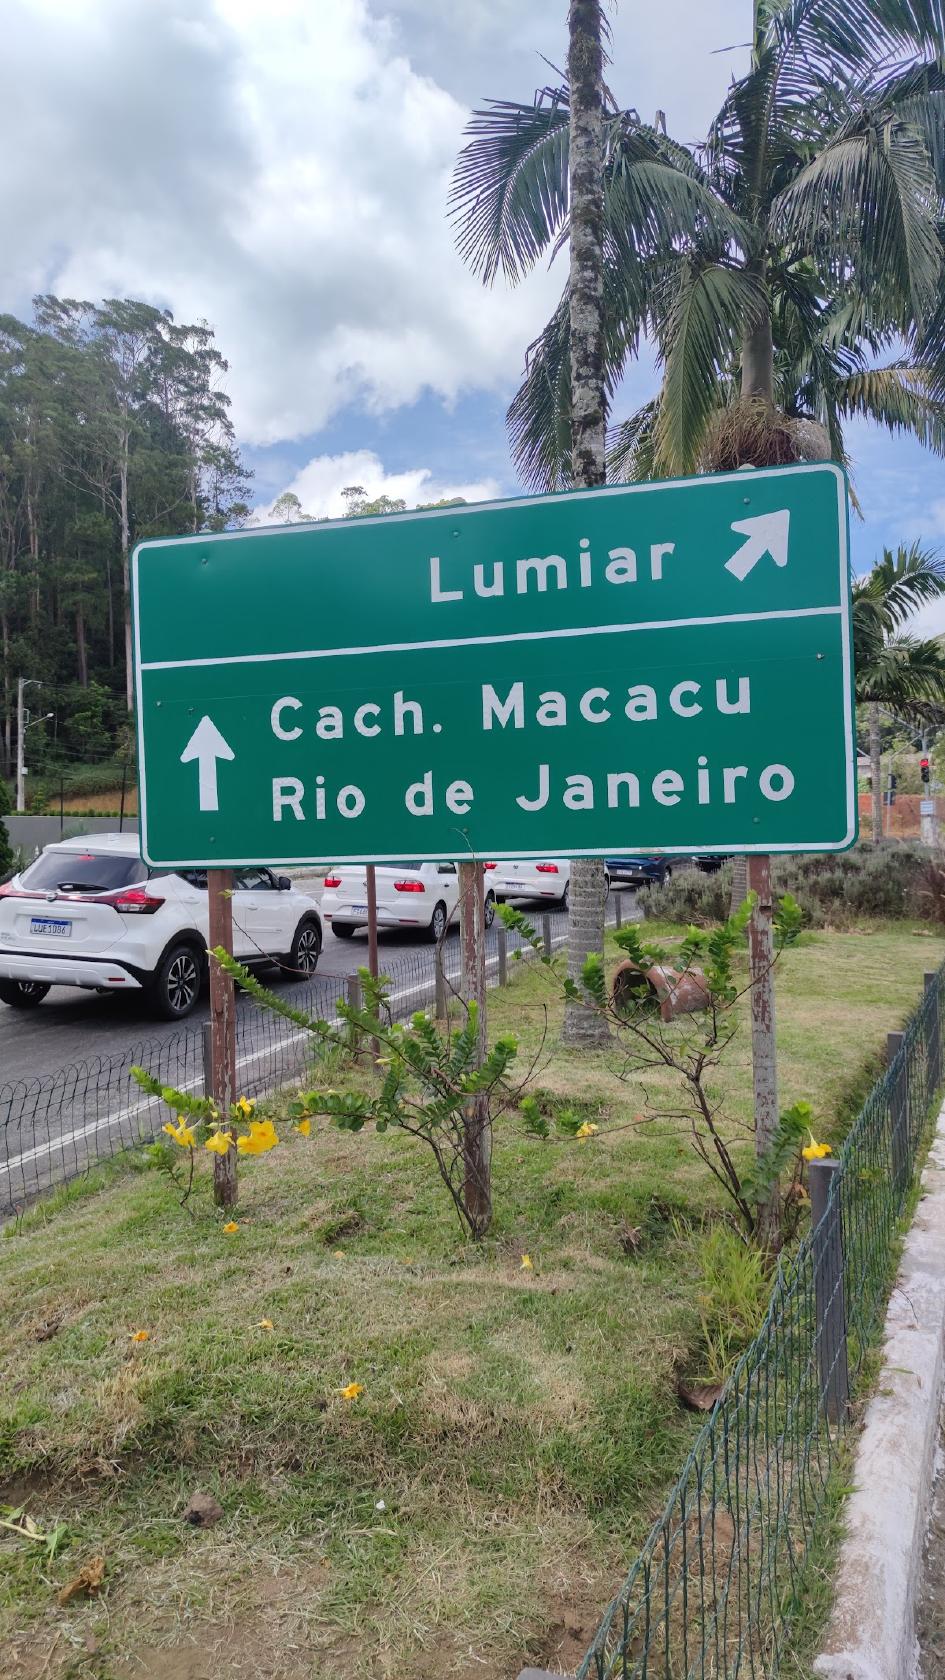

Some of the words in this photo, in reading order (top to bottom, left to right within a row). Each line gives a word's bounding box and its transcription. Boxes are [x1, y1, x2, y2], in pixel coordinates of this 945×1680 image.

[430, 538, 675, 603] Lumiar
[270, 690, 443, 741] Cach.
[482, 676, 752, 730] Macacu
[272, 775, 366, 822] Rio
[405, 770, 475, 816] de
[515, 756, 797, 812] Janeiro
